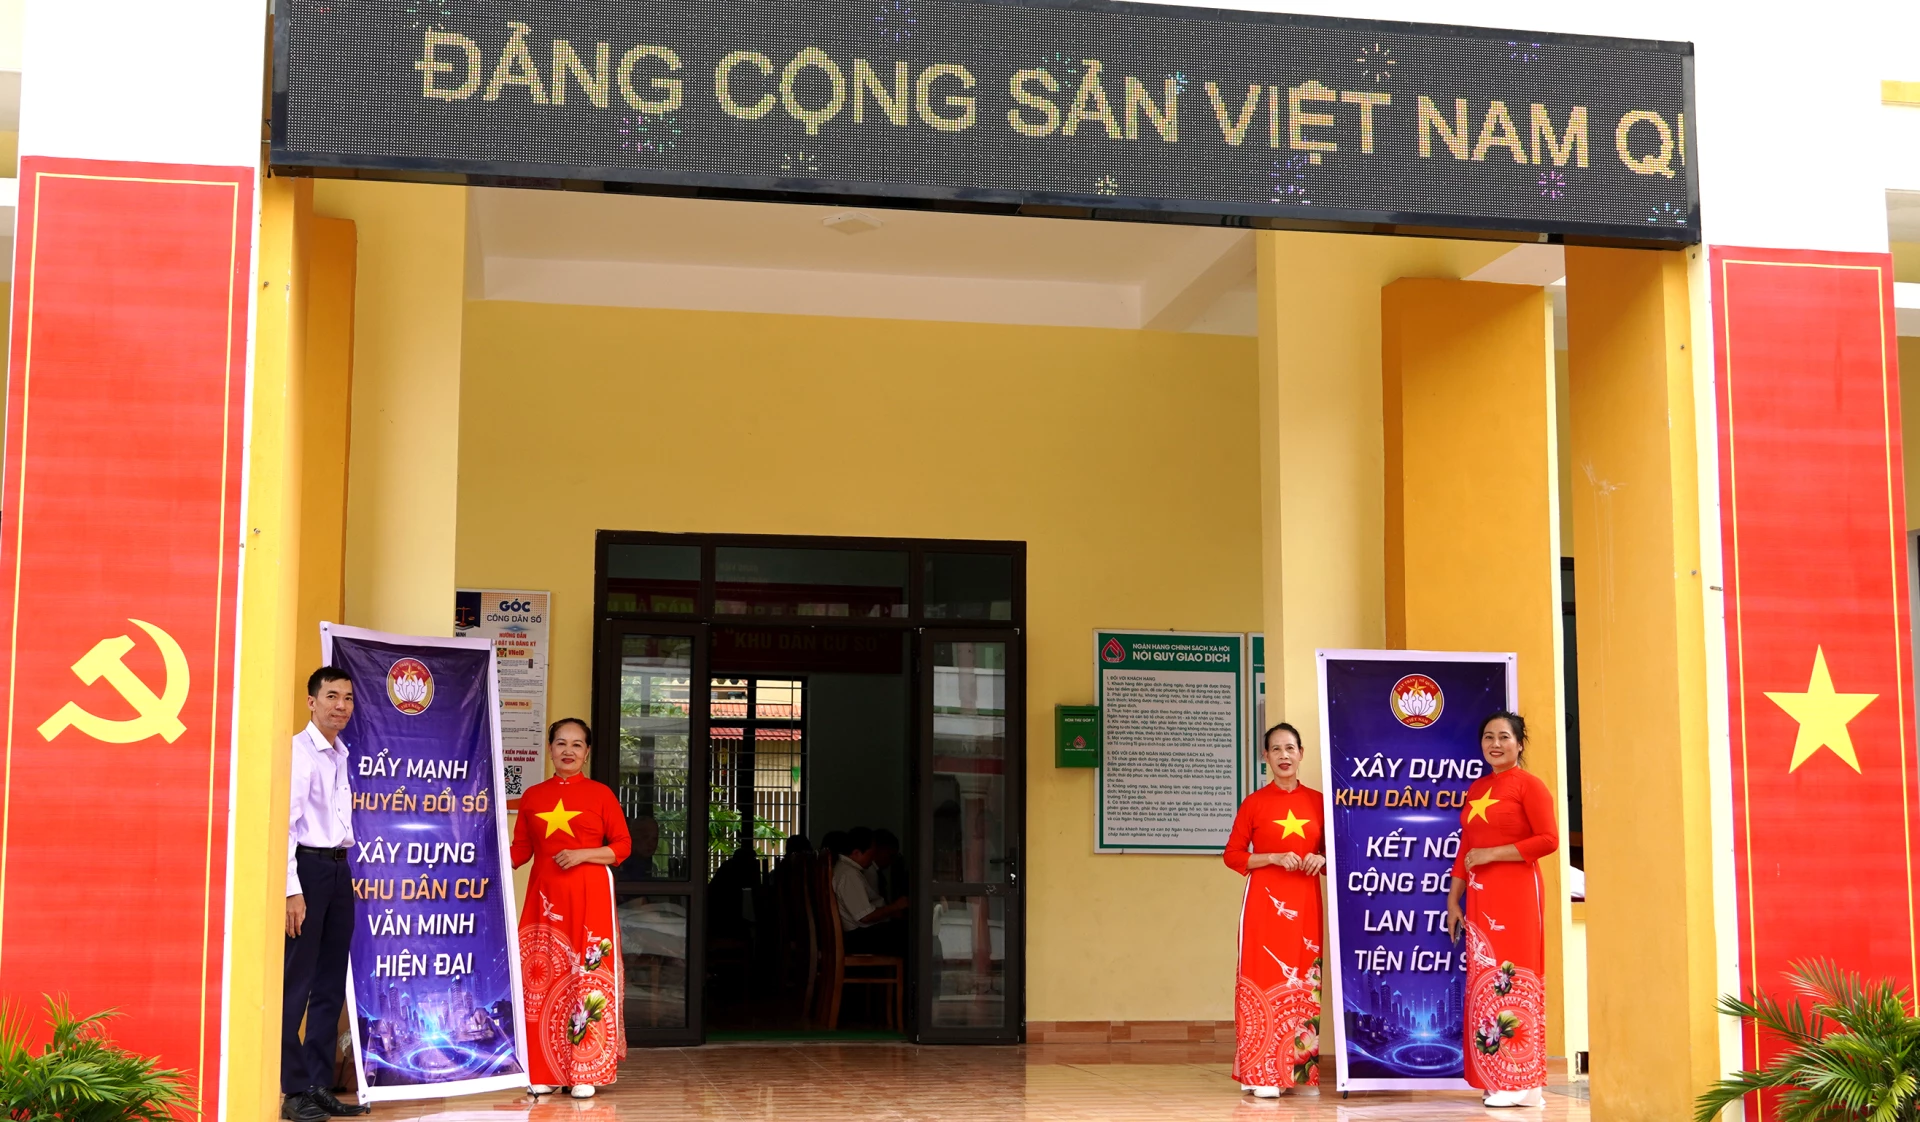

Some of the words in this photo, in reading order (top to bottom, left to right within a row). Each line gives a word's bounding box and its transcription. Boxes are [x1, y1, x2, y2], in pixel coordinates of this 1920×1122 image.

[414, 21, 684, 114] ĐẢNG
[714, 46, 977, 135] CỘNG
[1007, 58, 1178, 144] SẢN
[1204, 79, 1391, 164] VIỆT
[1418, 95, 1589, 168] NAM
[1615, 109, 1685, 178] Q
[486, 613, 510, 623] CÔNG
[511, 614, 529, 623] DÂN
[531, 613, 542, 624] SỐ
[499, 598, 532, 613] GÓC
[1132, 651, 1152, 662] NỘI
[1153, 651, 1174, 662] QUY
[1176, 653, 1203, 662] GIAO
[1204, 653, 1231, 663] DỊCH
[1218, 645, 1230, 653] HỘI
[358, 748, 402, 777] ĐẨY
[406, 758, 468, 783] MẠNH
[1351, 752, 1403, 778] XÂY
[1408, 757, 1484, 784] DỰNG
[352, 785, 417, 812] HUYỂN
[422, 787, 456, 812] ĐỔI
[461, 788, 489, 812] SỐ
[1335, 788, 1379, 807] KHU
[1384, 785, 1430, 807] DÂN
[1435, 789, 1468, 808] CƯ
[356, 836, 402, 864] XÂY
[407, 841, 476, 869] DỰNG
[1366, 827, 1417, 858] KẾT
[1423, 827, 1463, 859] NỐ
[353, 877, 395, 901] KHU
[400, 873, 448, 900] DÂN
[454, 878, 489, 899] CƯ
[1348, 867, 1414, 896] CỘNG
[368, 909, 411, 936] VĂN
[417, 913, 475, 936] MINH
[1364, 909, 1415, 932] LAN
[376, 949, 427, 982] HIỆN
[433, 952, 473, 980] ĐẠI
[1354, 945, 1403, 976] TIỆN
[1410, 945, 1450, 972] ÍCH
